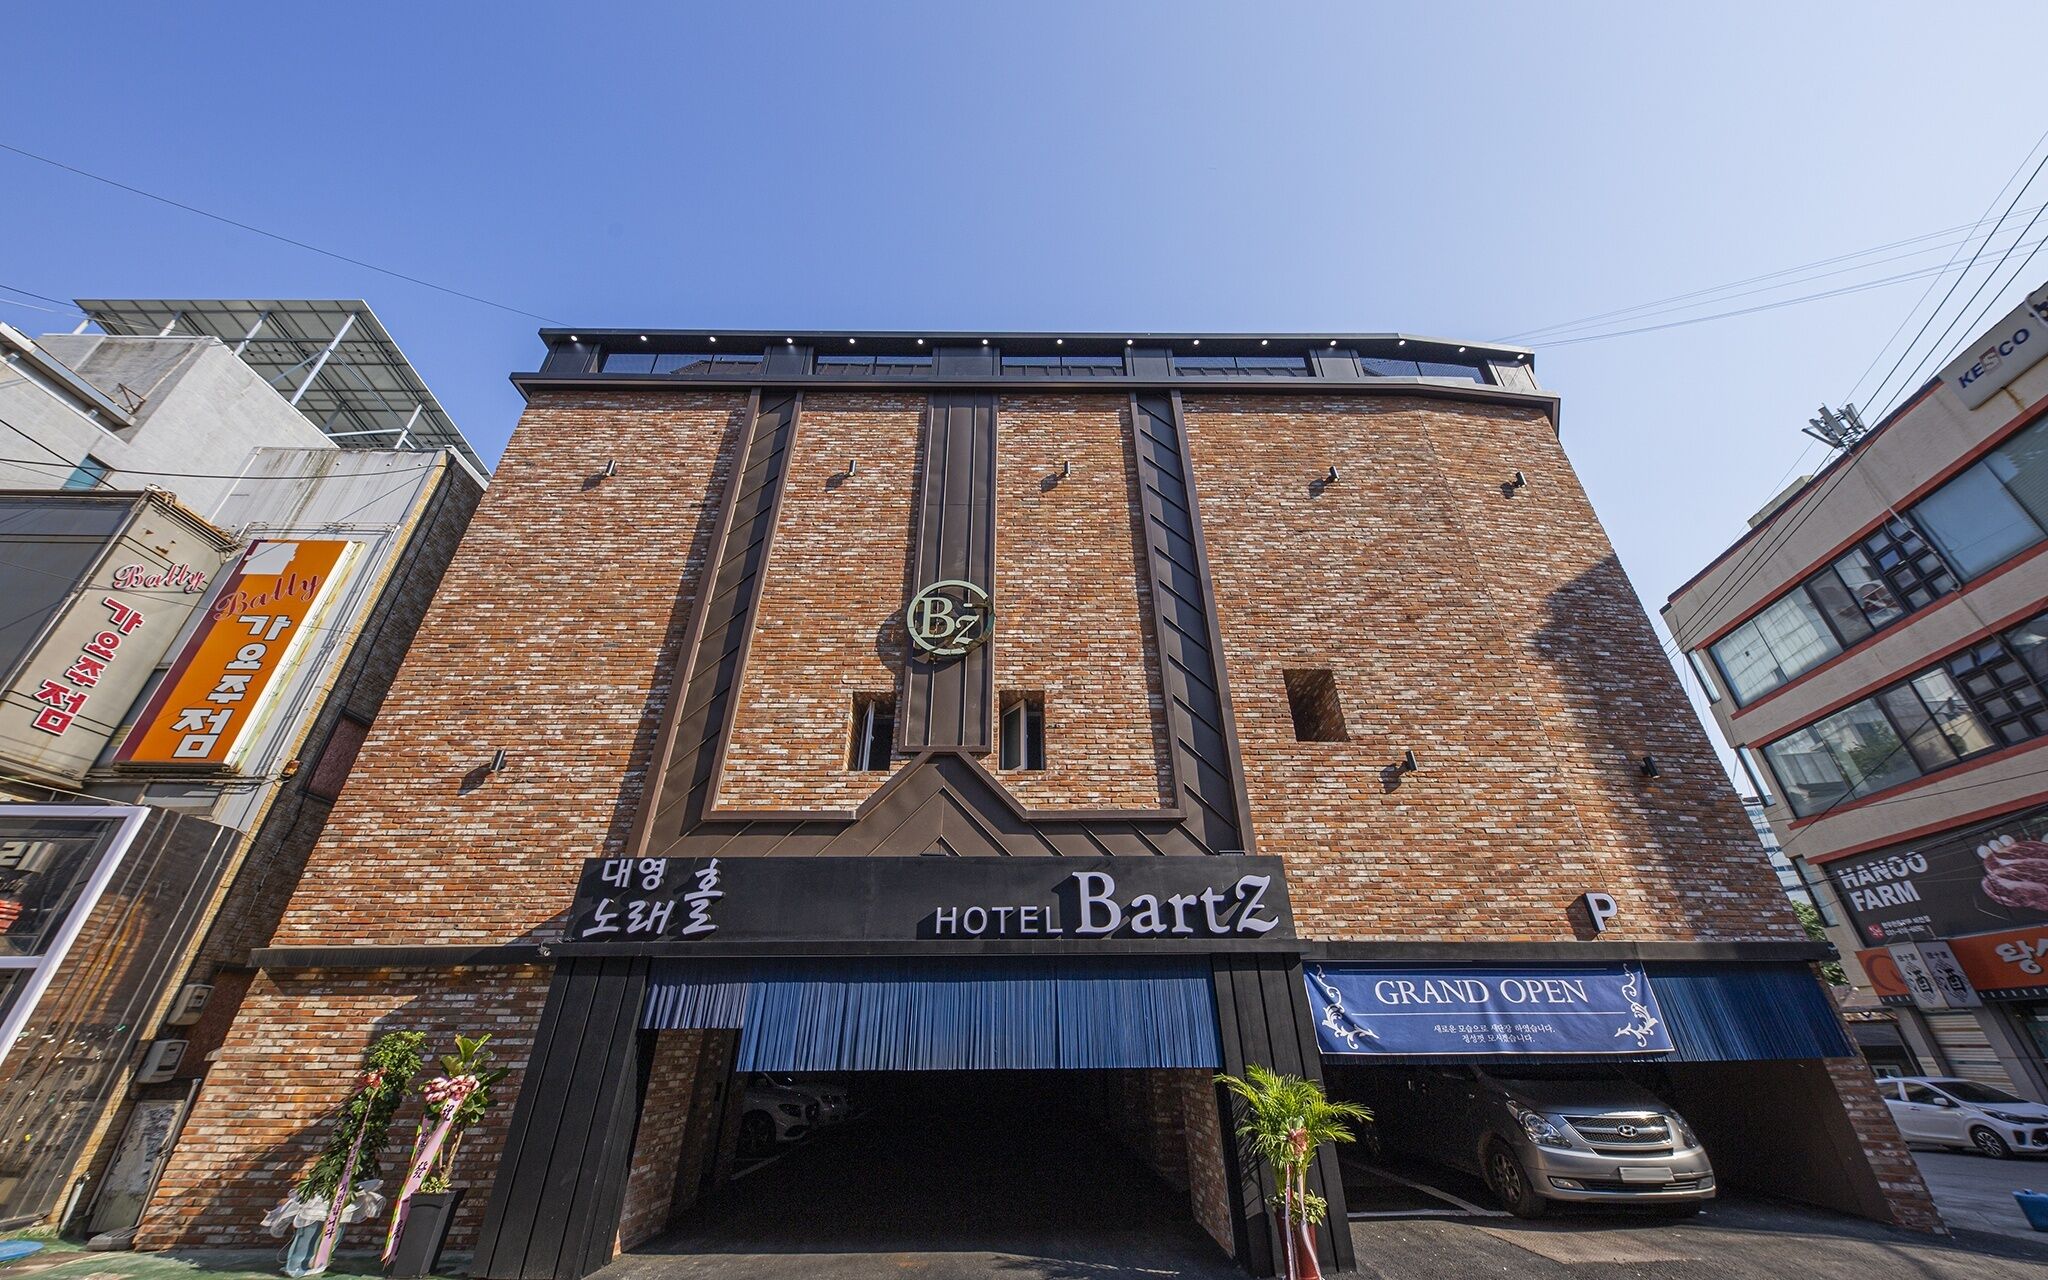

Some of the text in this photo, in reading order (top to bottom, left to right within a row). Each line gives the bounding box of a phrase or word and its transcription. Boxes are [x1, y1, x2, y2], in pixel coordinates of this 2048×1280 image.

[1958, 328, 2030, 389] KESCO
[113, 564, 207, 594] Bally
[213, 573, 322, 621] Bally
[32, 596, 146, 736] 가요주점
[171, 615, 292, 759] 가요주점
[601, 857, 667, 891] 대영
[582, 857, 726, 938] 노래 홀
[1585, 892, 1618, 932] P
[1849, 880, 1922, 912] FARM
[935, 906, 1063, 934] HOTEL
[1374, 979, 1590, 1005] GRAND OPEN
[1433, 1024, 1457, 1034] 새로운
[1458, 1024, 1489, 1034] 모습으로
